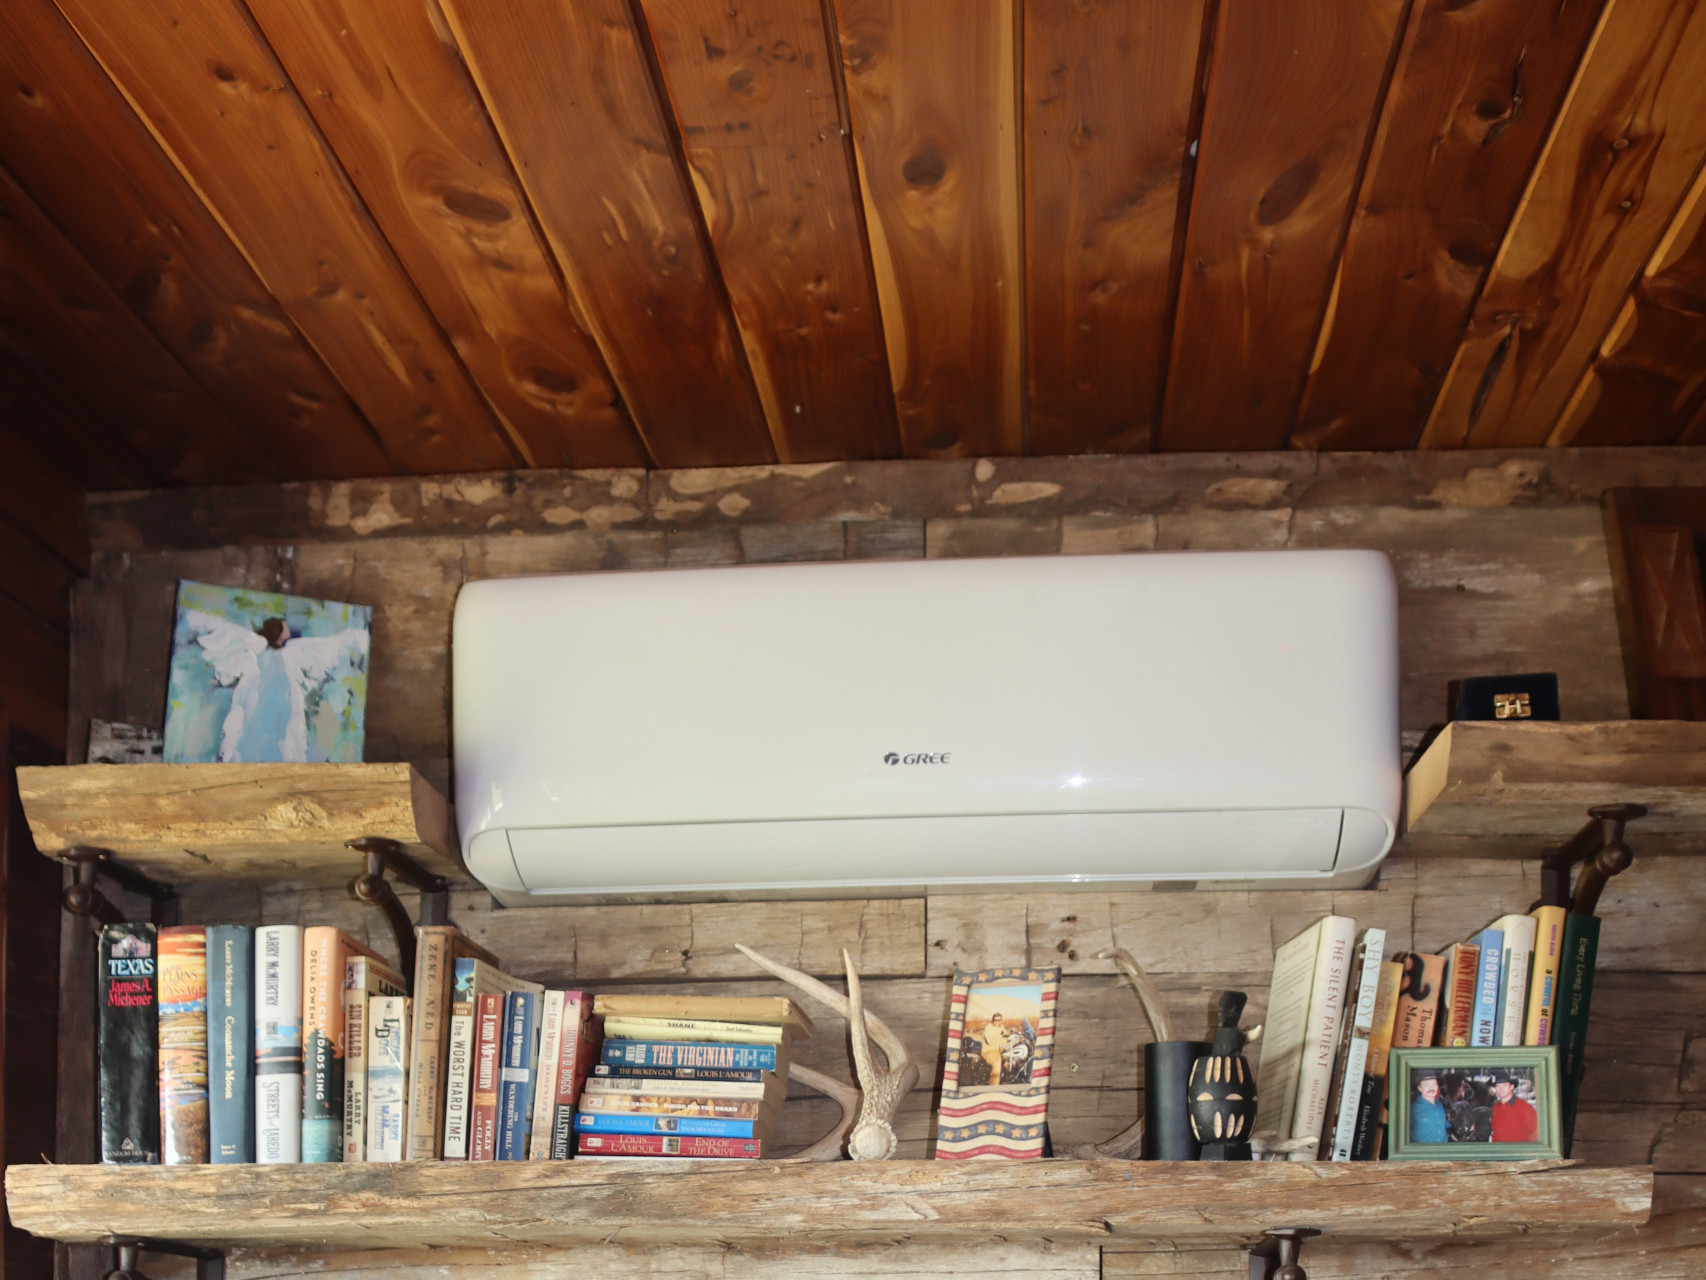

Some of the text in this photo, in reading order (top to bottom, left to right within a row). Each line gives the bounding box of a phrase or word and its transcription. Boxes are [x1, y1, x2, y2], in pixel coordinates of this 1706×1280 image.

[903, 752, 951, 764] GREE
[266, 930, 280, 958] LARRY
[1365, 938, 1381, 975] SHY
[1576, 937, 1588, 962] Every
[108, 958, 154, 976] TEXAS
[162, 968, 198, 982] PLAINS
[1482, 949, 1499, 1004] CROWDED
[1573, 963, 1585, 991] Living
[108, 993, 152, 1007] Michener
[109, 979, 152, 994] James A.
[162, 983, 204, 998] PASSAGE
[265, 961, 280, 1007] McMURTRY
[308, 950, 318, 1026] DELIA OWENS
[424, 943, 438, 1030] ZEKE NED
[1452, 951, 1477, 1037] TONY HILLERMAN
[1505, 952, 1520, 1038] HORSES
[1317, 939, 1346, 1069] THE SILENT PATIENT
[1358, 984, 1376, 1021] BOY
[1541, 1009, 1549, 1017] of
[315, 938, 328, 1100] WHERE THE CRAWDADS SING
[347, 1003, 362, 1059] SIN KILLER
[482, 1014, 497, 1041] LARRY
[513, 1015, 525, 1034] LARRY
[667, 1022, 695, 1030] SHANE
[1402, 1005, 1418, 1041] Mason
[1417, 1008, 1433, 1047] Thoma
[1479, 1019, 1492, 1045] NOW
[225, 1015, 235, 1099] Comanche Moon
[560, 1027, 576, 1095] JOHNNY D. BOGGS
[619, 1068, 673, 1077] THE BROKEN GUN
[652, 1045, 674, 1066] THE
[676, 1045, 735, 1068] VIRGINIAN
[448, 1020, 466, 1142] The WORST HARD TIME
[696, 1070, 753, 1079] LOUIS L'AMOUR
[1305, 1079, 1320, 1131] MICHAELIDES
[1317, 1096, 1325, 1116] ALEX
[1343, 1043, 1363, 1141] MONTY ROBERTS
[263, 1081, 280, 1159] STREETS LAREDO
[345, 1080, 354, 1138] McMURTRY
[354, 1092, 362, 1125] LARRY
[504, 1083, 517, 1150] WANDERING HILL
[598, 1117, 650, 1127] LOUIS L'AMOUR
[473, 1127, 483, 1160] GLORY
[484, 1119, 492, 1151] FOLLY
[554, 1105, 570, 1160] KILLSTRAIGH
[610, 1143, 655, 1153] L'AMOUR
[619, 1136, 647, 1145] LOUIS
[695, 1137, 729, 1148] END OF
[689, 1146, 735, 1156] THE DRIVE
